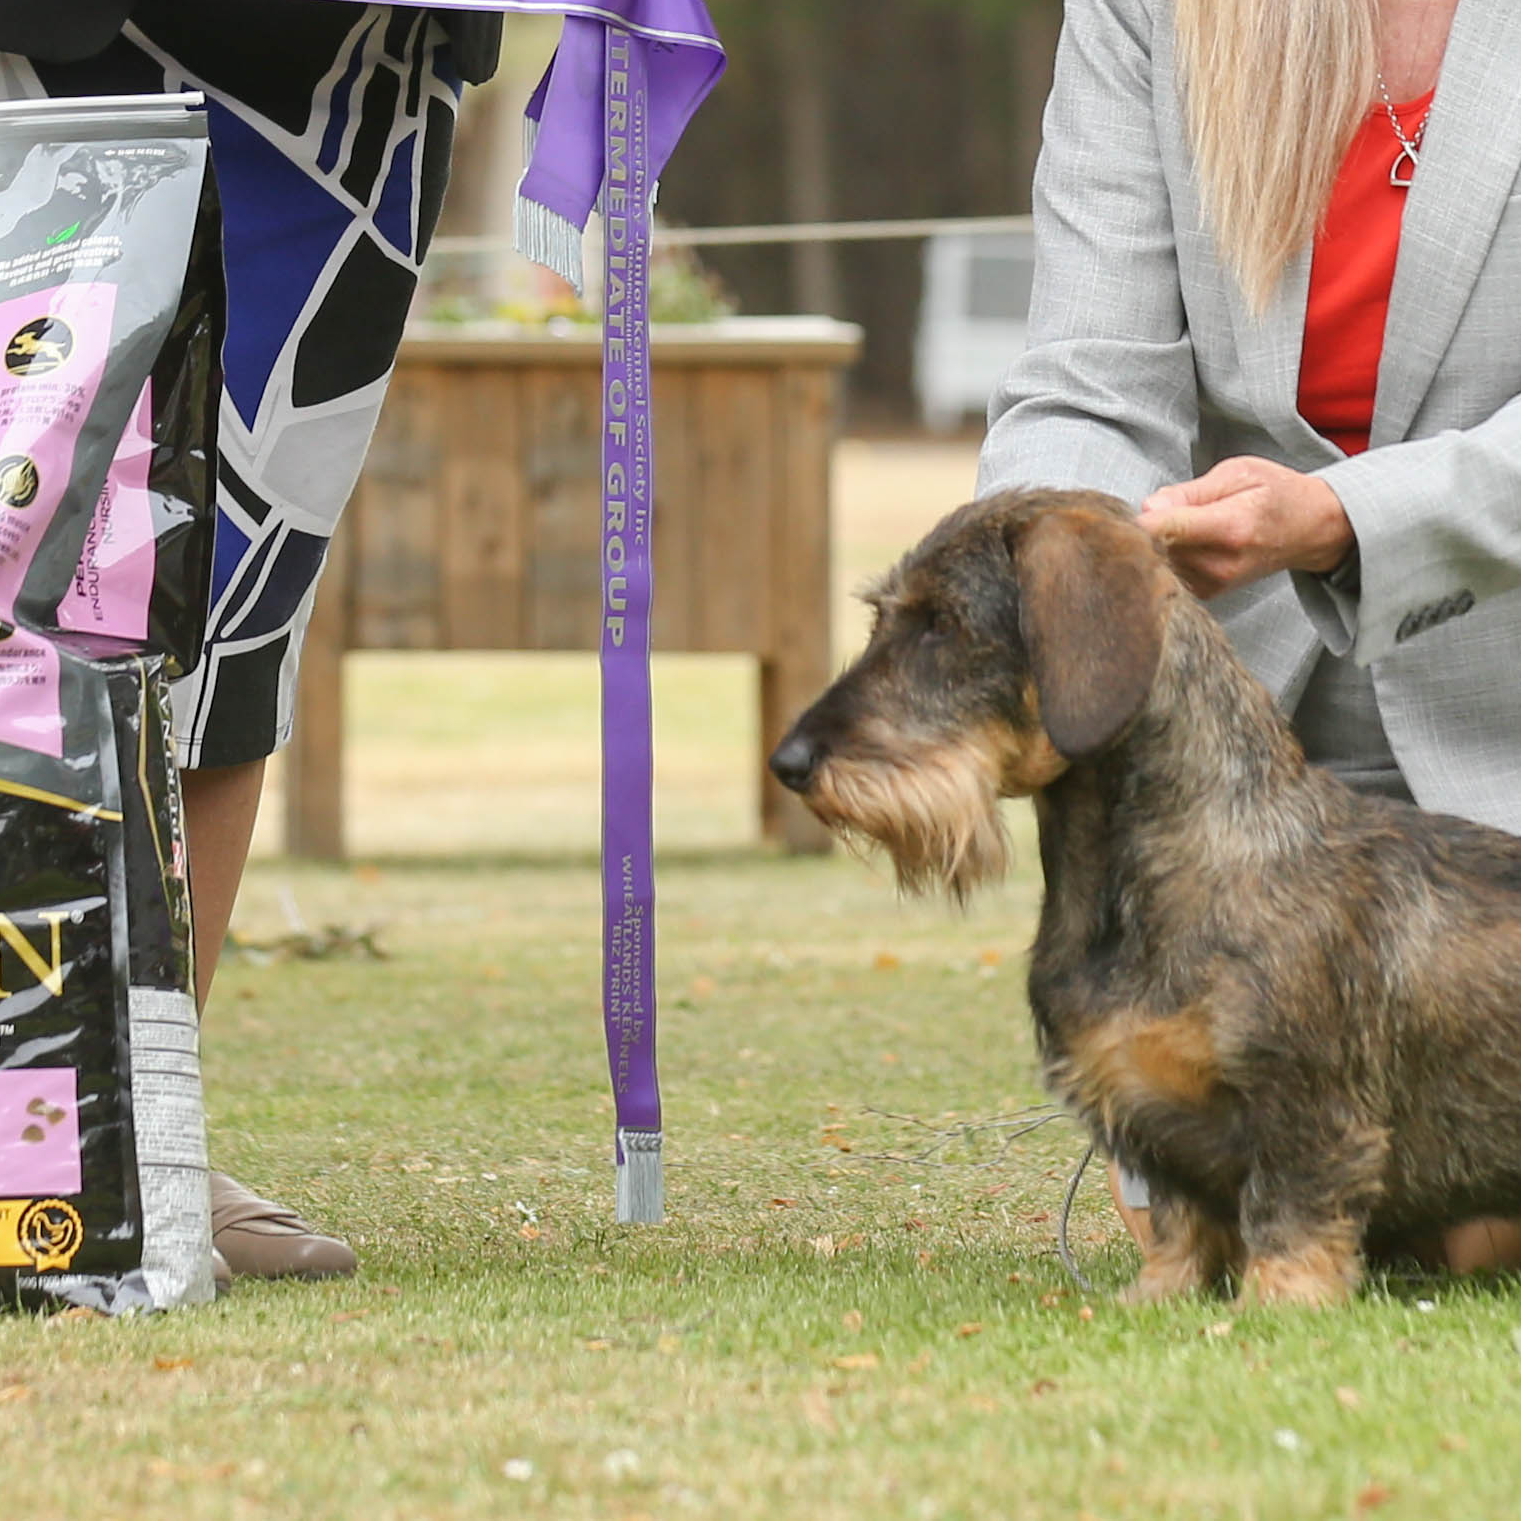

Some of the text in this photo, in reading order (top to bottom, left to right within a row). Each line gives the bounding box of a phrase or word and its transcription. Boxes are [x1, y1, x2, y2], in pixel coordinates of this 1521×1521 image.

[632, 88, 647, 546] Canterbury Junior Kennel Society Inc
[608, 379, 627, 446] OF
[607, 462, 627, 647] GROUP
[618, 854, 634, 1095] WHEATLANDS KENNELS
[630, 904, 644, 1045] Sponsored by
